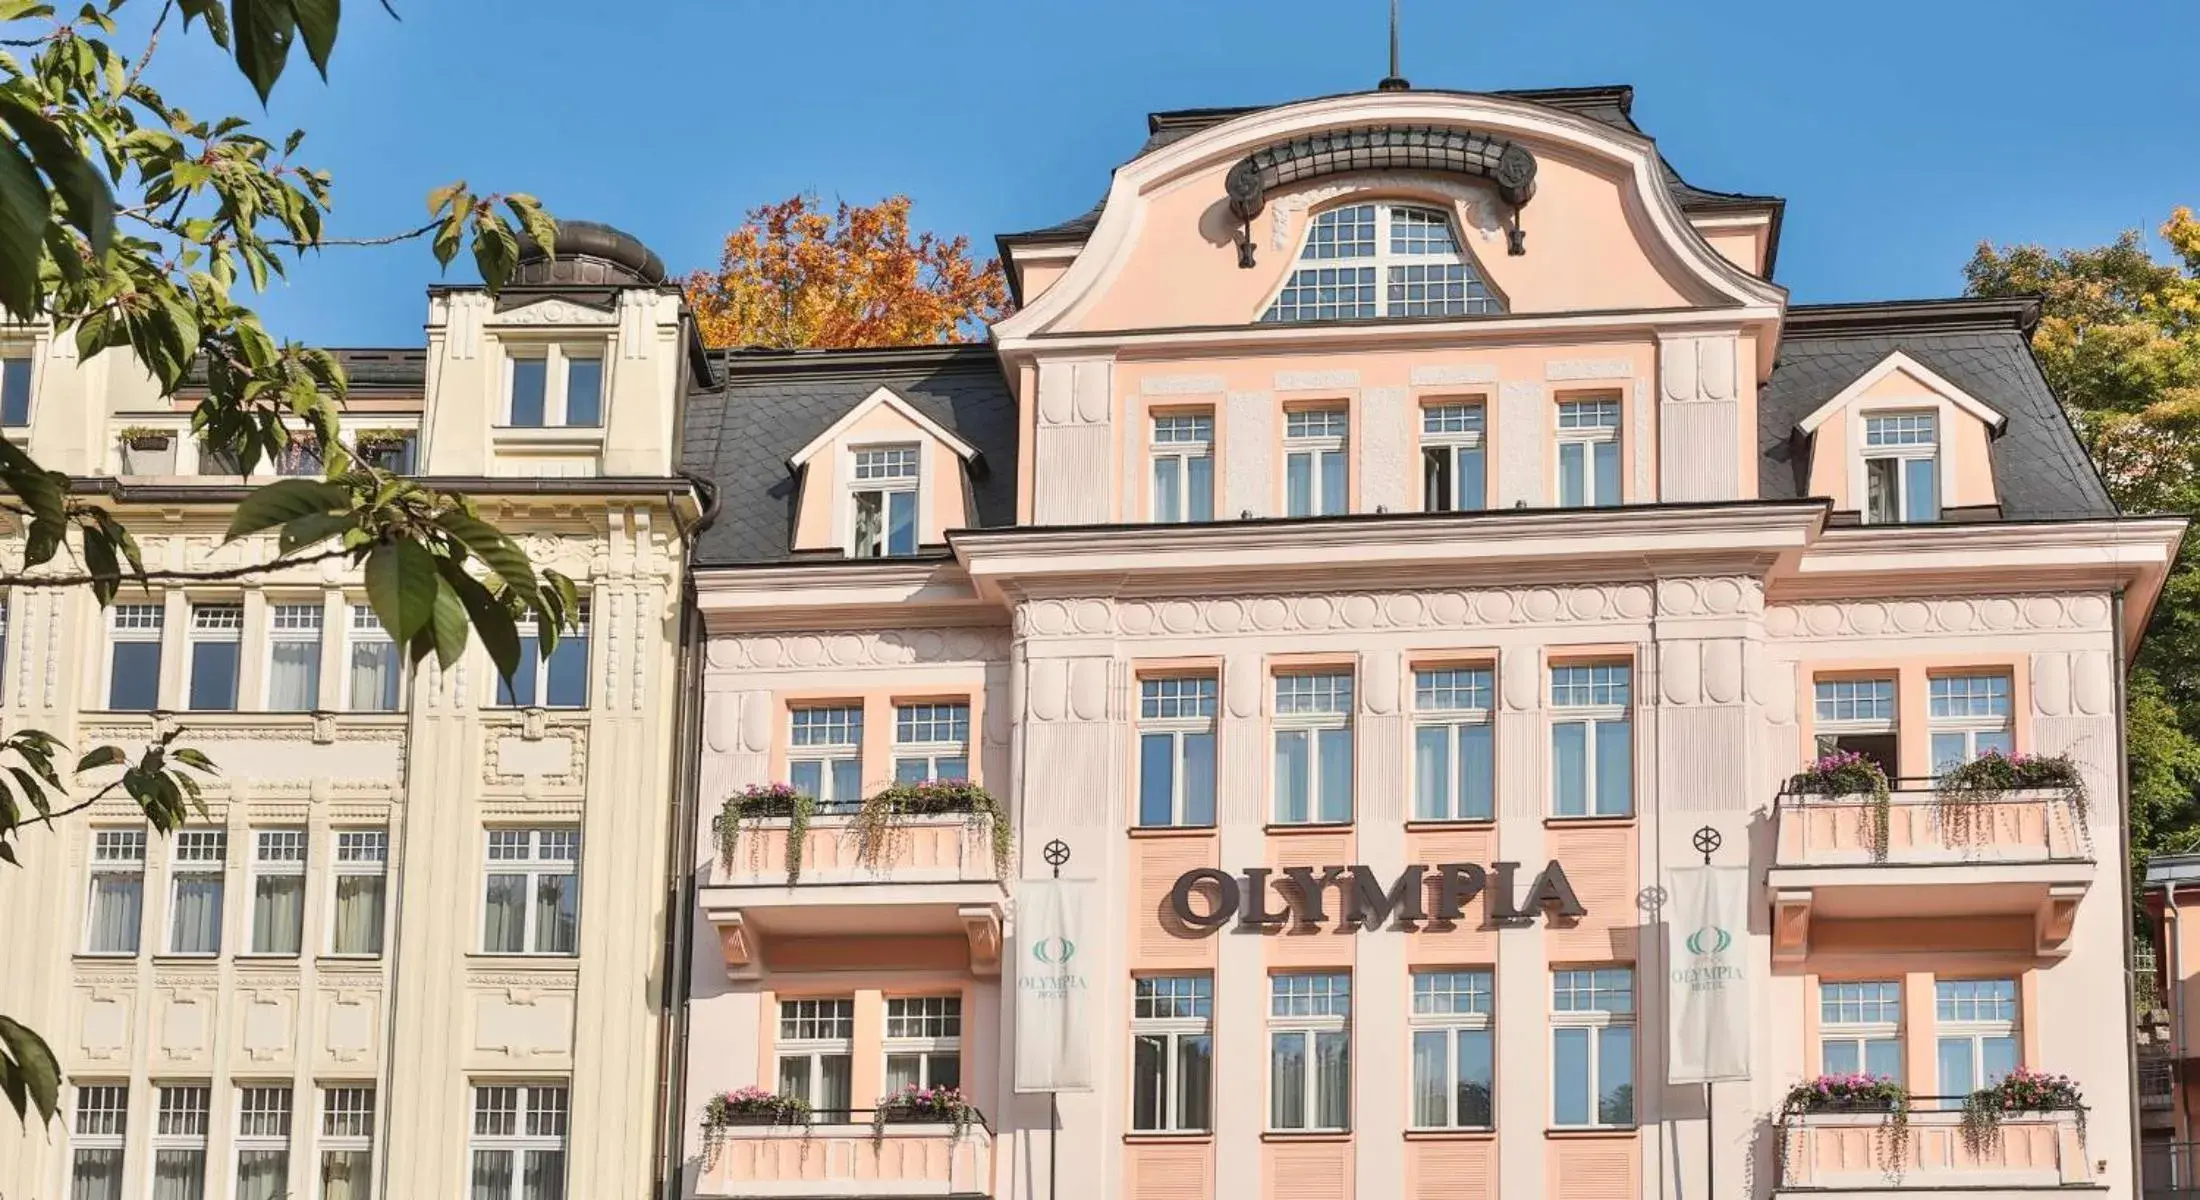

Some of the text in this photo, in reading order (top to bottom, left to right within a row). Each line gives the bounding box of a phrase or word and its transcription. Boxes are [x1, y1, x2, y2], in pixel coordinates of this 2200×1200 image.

[1171, 859, 1587, 925] OLYMPIA
[1018, 975, 1087, 989] OLYMPIA
[1672, 966, 1744, 983] OLYMPIA
